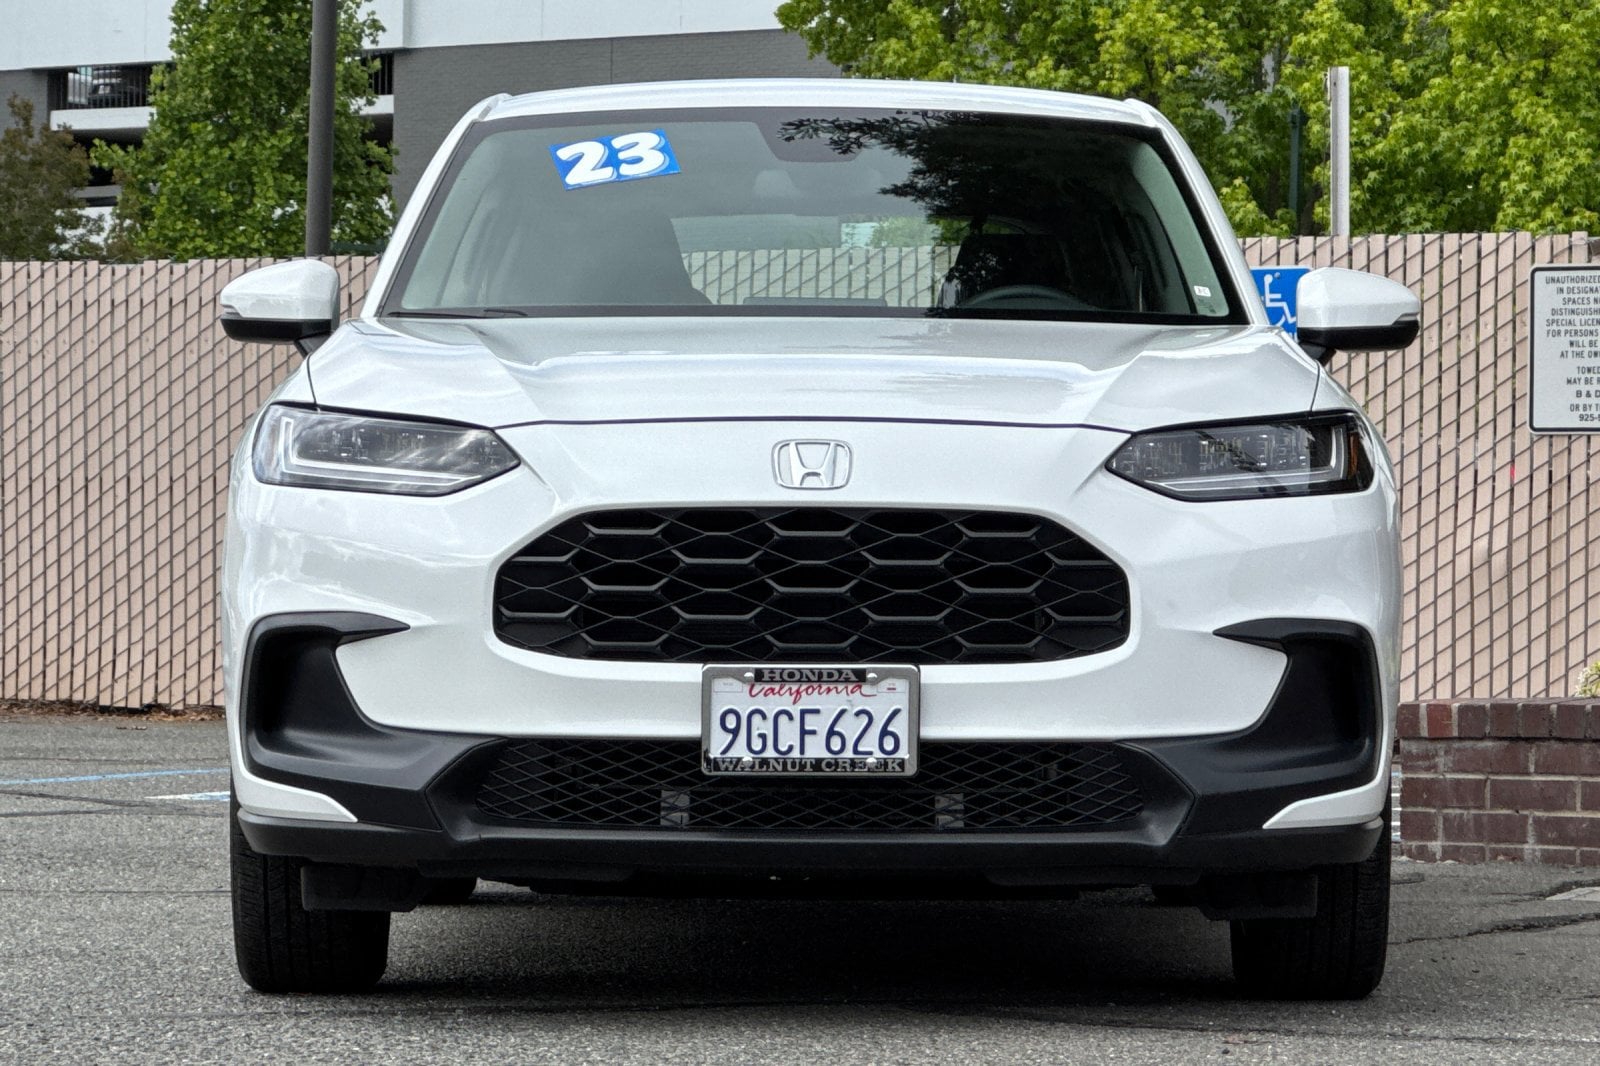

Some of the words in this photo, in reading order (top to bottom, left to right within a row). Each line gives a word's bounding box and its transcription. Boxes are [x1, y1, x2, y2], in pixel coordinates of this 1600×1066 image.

[556, 132, 668, 186] 23
[1562, 297, 1590, 305] SPACES
[1546, 318, 1576, 326] SPECIAL
[1547, 329, 1561, 337] FOR
[1564, 329, 1598, 337] PERSONS
[762, 669, 858, 682] HONDA
[748, 683, 877, 705] California
[720, 708, 902, 756] 9GCF626
[716, 758, 816, 772] WALNUT
[821, 758, 903, 772] CREEK
